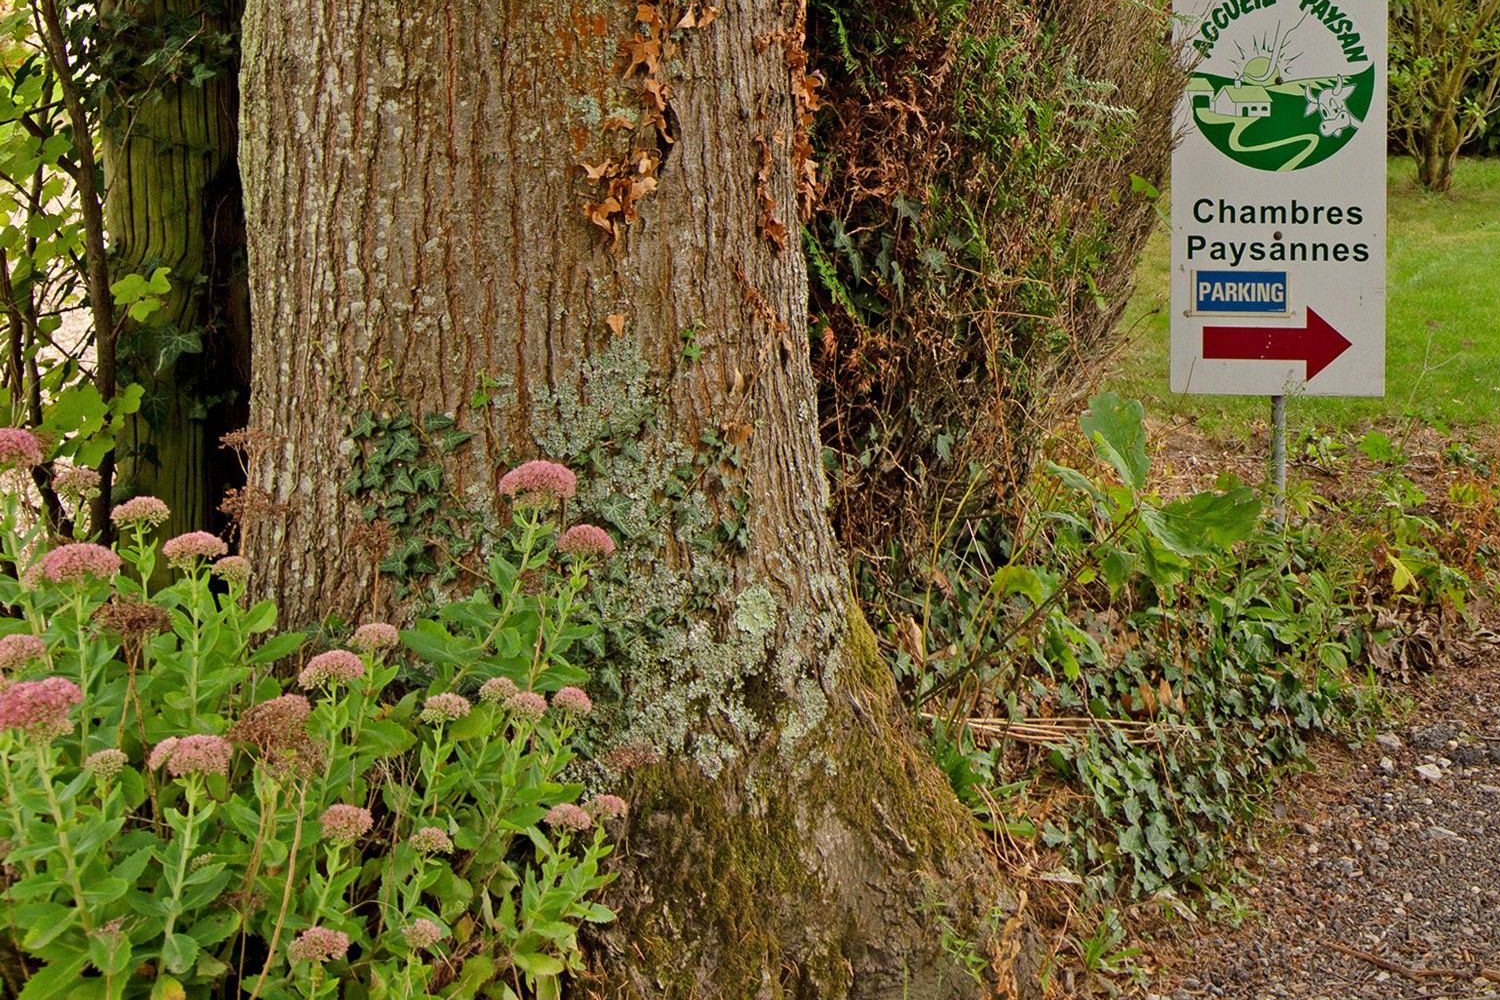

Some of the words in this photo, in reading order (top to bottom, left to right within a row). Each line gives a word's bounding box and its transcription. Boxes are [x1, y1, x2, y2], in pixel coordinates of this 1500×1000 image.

[1193, 198, 1363, 225] Chambres
[1187, 235, 1369, 267] Paysannes
[1198, 282, 1285, 303] PARKING
